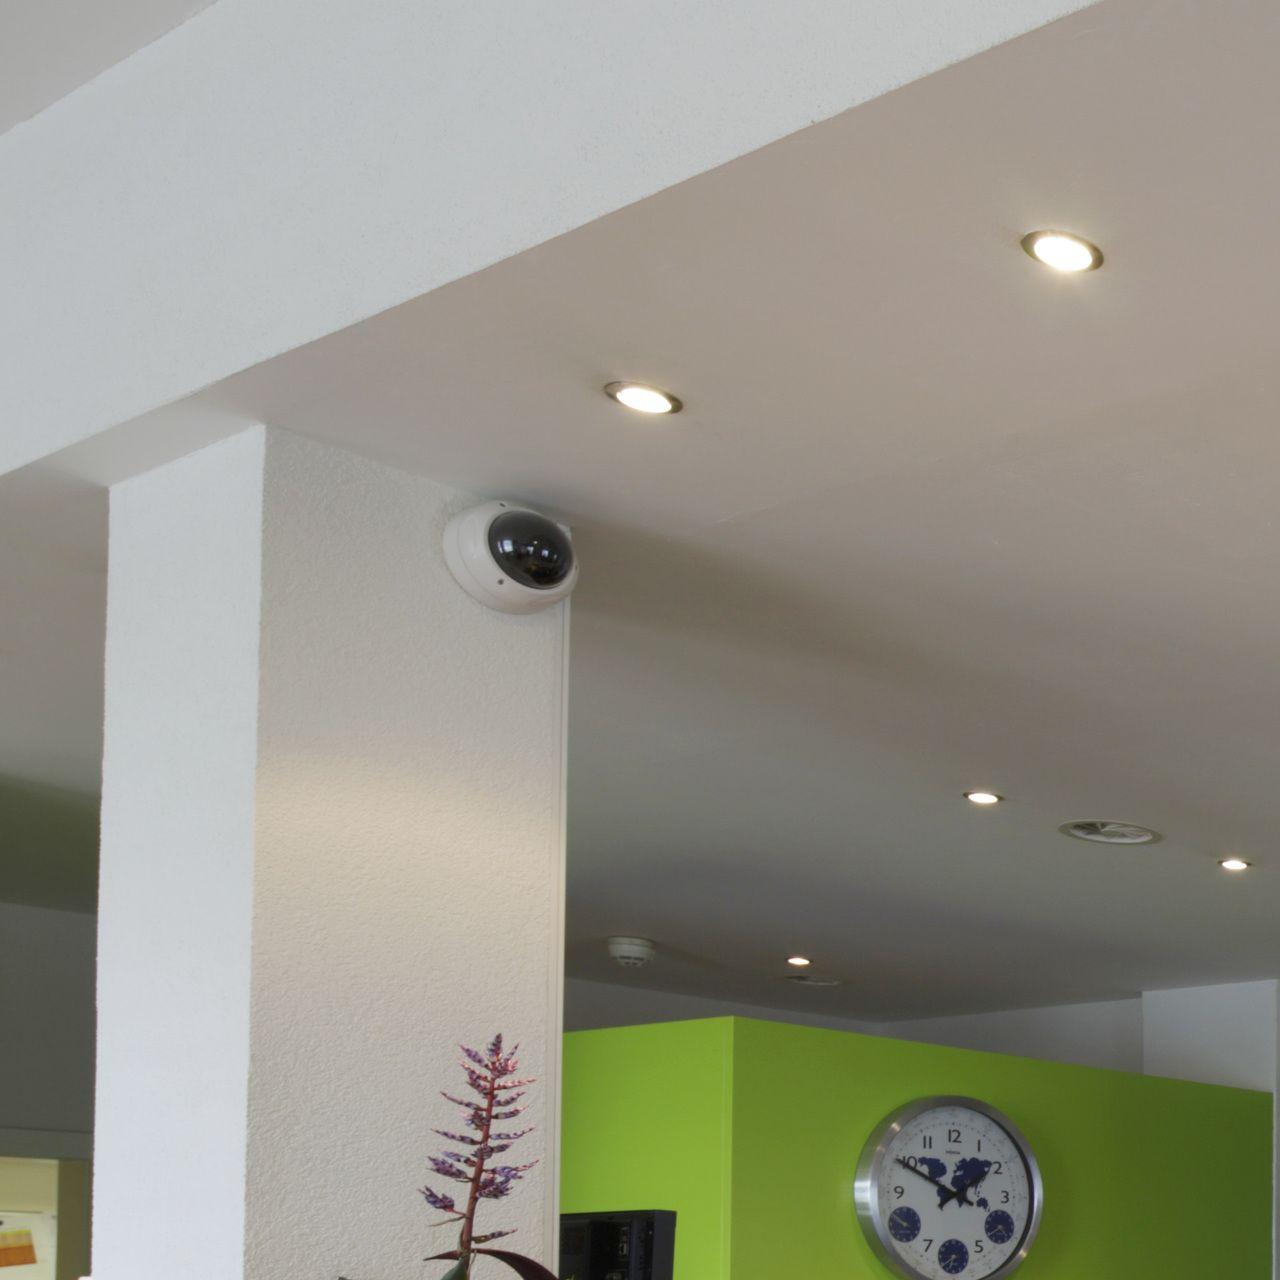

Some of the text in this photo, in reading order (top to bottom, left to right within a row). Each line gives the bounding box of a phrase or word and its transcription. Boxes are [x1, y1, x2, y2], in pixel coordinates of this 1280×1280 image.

[923, 1135, 932, 1149] 11
[948, 1129, 962, 1143] 12
[992, 1161, 1003, 1175] 2
[893, 1186, 905, 1199] 9
[1001, 1190, 1010, 1204] 3
[923, 1239, 933, 1252] 7
[974, 1240, 984, 1253] 5
